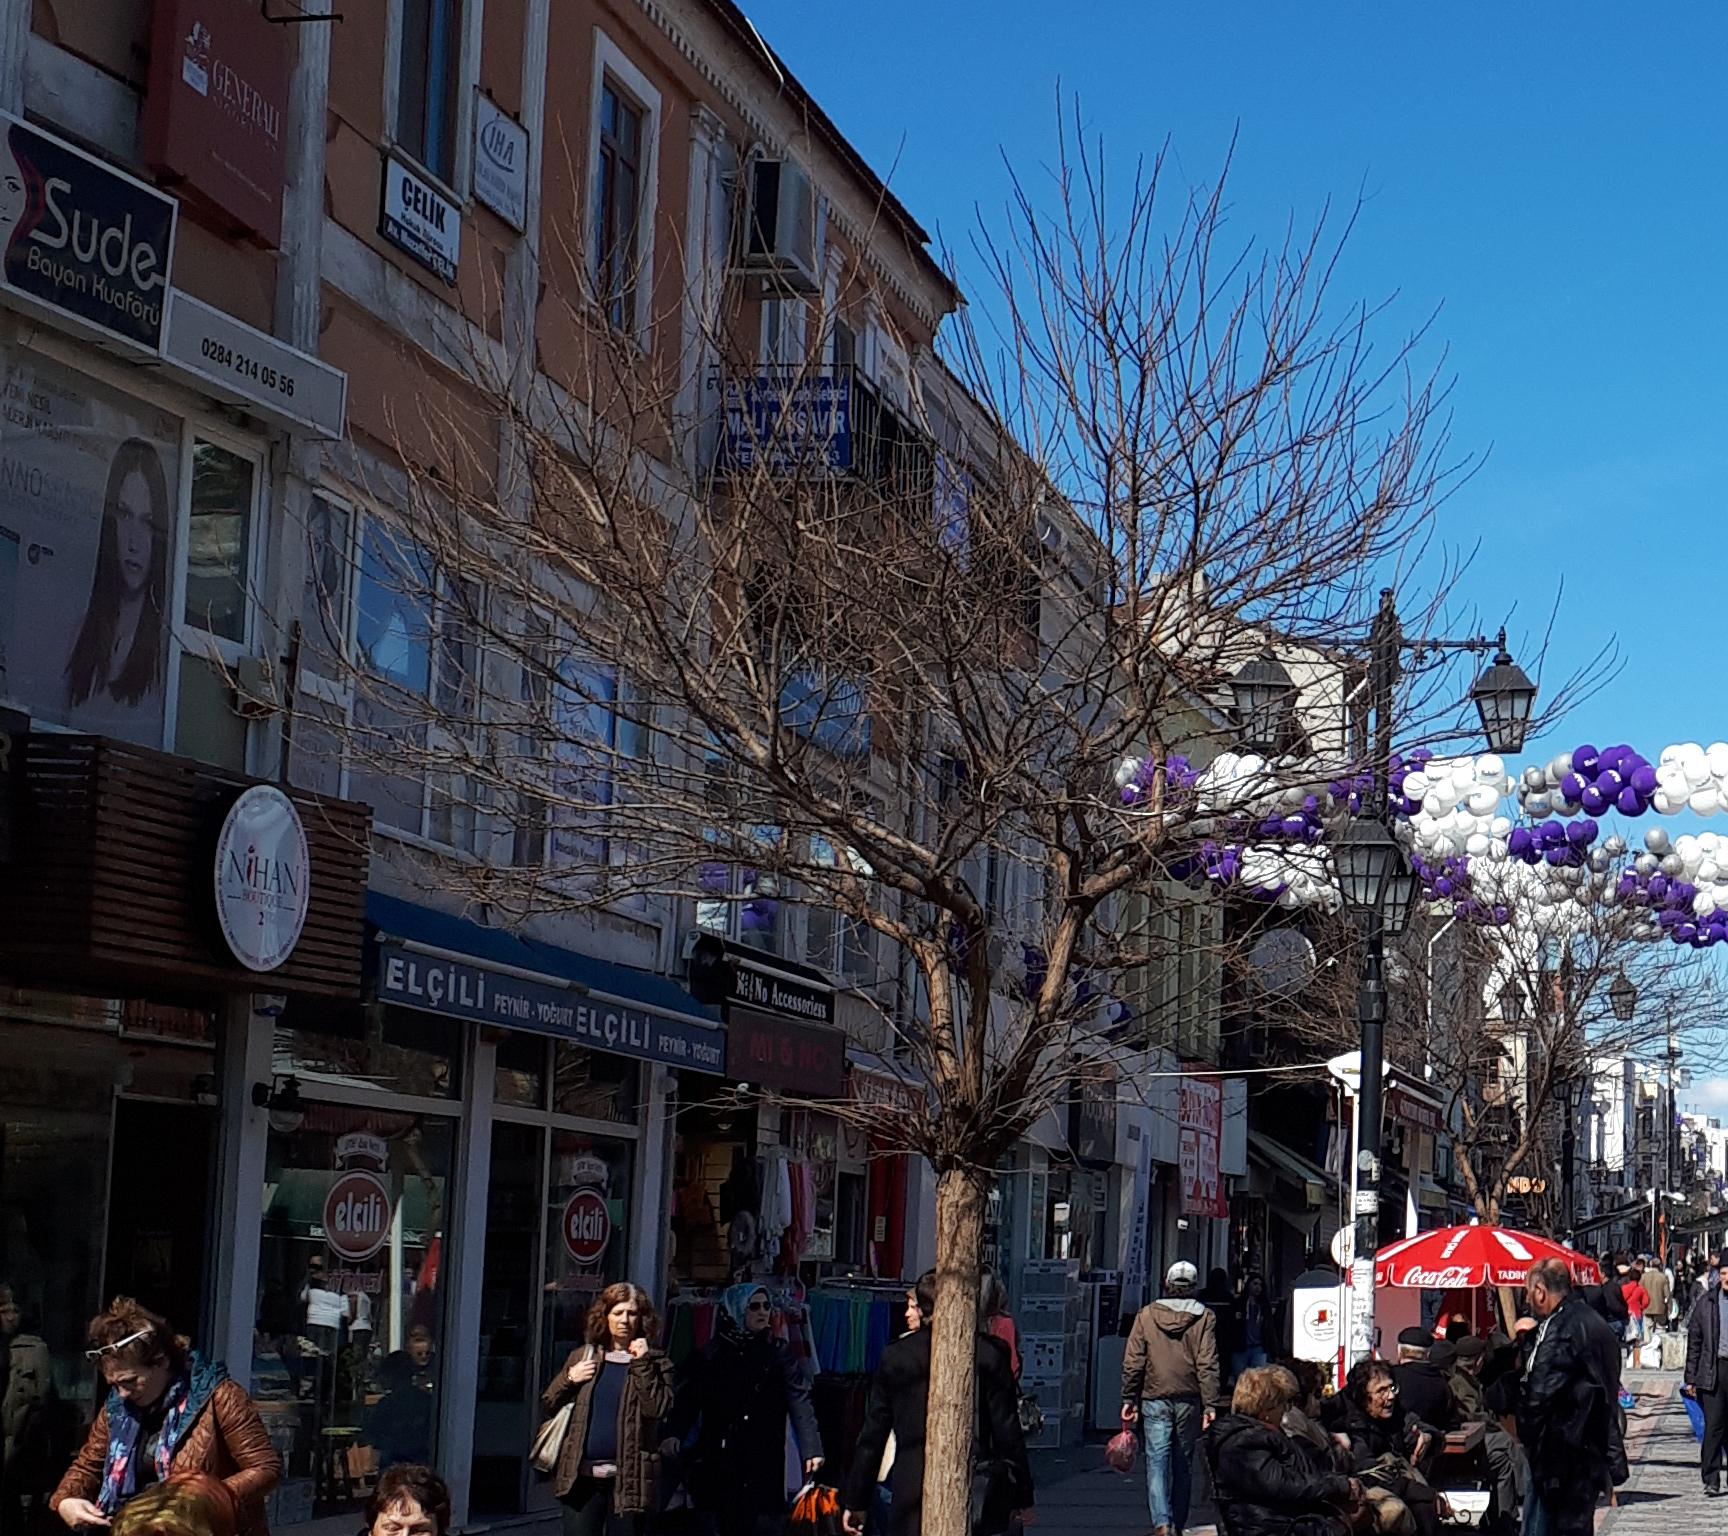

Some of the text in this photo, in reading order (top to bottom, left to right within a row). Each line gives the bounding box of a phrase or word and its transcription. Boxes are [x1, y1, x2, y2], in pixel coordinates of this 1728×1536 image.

[212, 58, 280, 142] GENERALI
[29, 177, 166, 291] Sude
[402, 177, 445, 234] ÇELİK
[27, 245, 160, 326] Bayan Kuaförü
[202, 338, 294, 397] 0284 214 05 56
[228, 845, 300, 896] NİHAN
[385, 957, 486, 1009] ELÇİLİ
[493, 993, 530, 1020] PEYNİR
[537, 999, 575, 1029] YOĞURT
[575, 1005, 651, 1049] ELÇİLİ
[658, 1034, 687, 1055] PEYNİR
[691, 1039, 721, 1066] YOĞURT
[334, 1191, 381, 1238] elçili
[570, 1205, 604, 1246] elçili
[1497, 1270, 1528, 1280] TADIN
